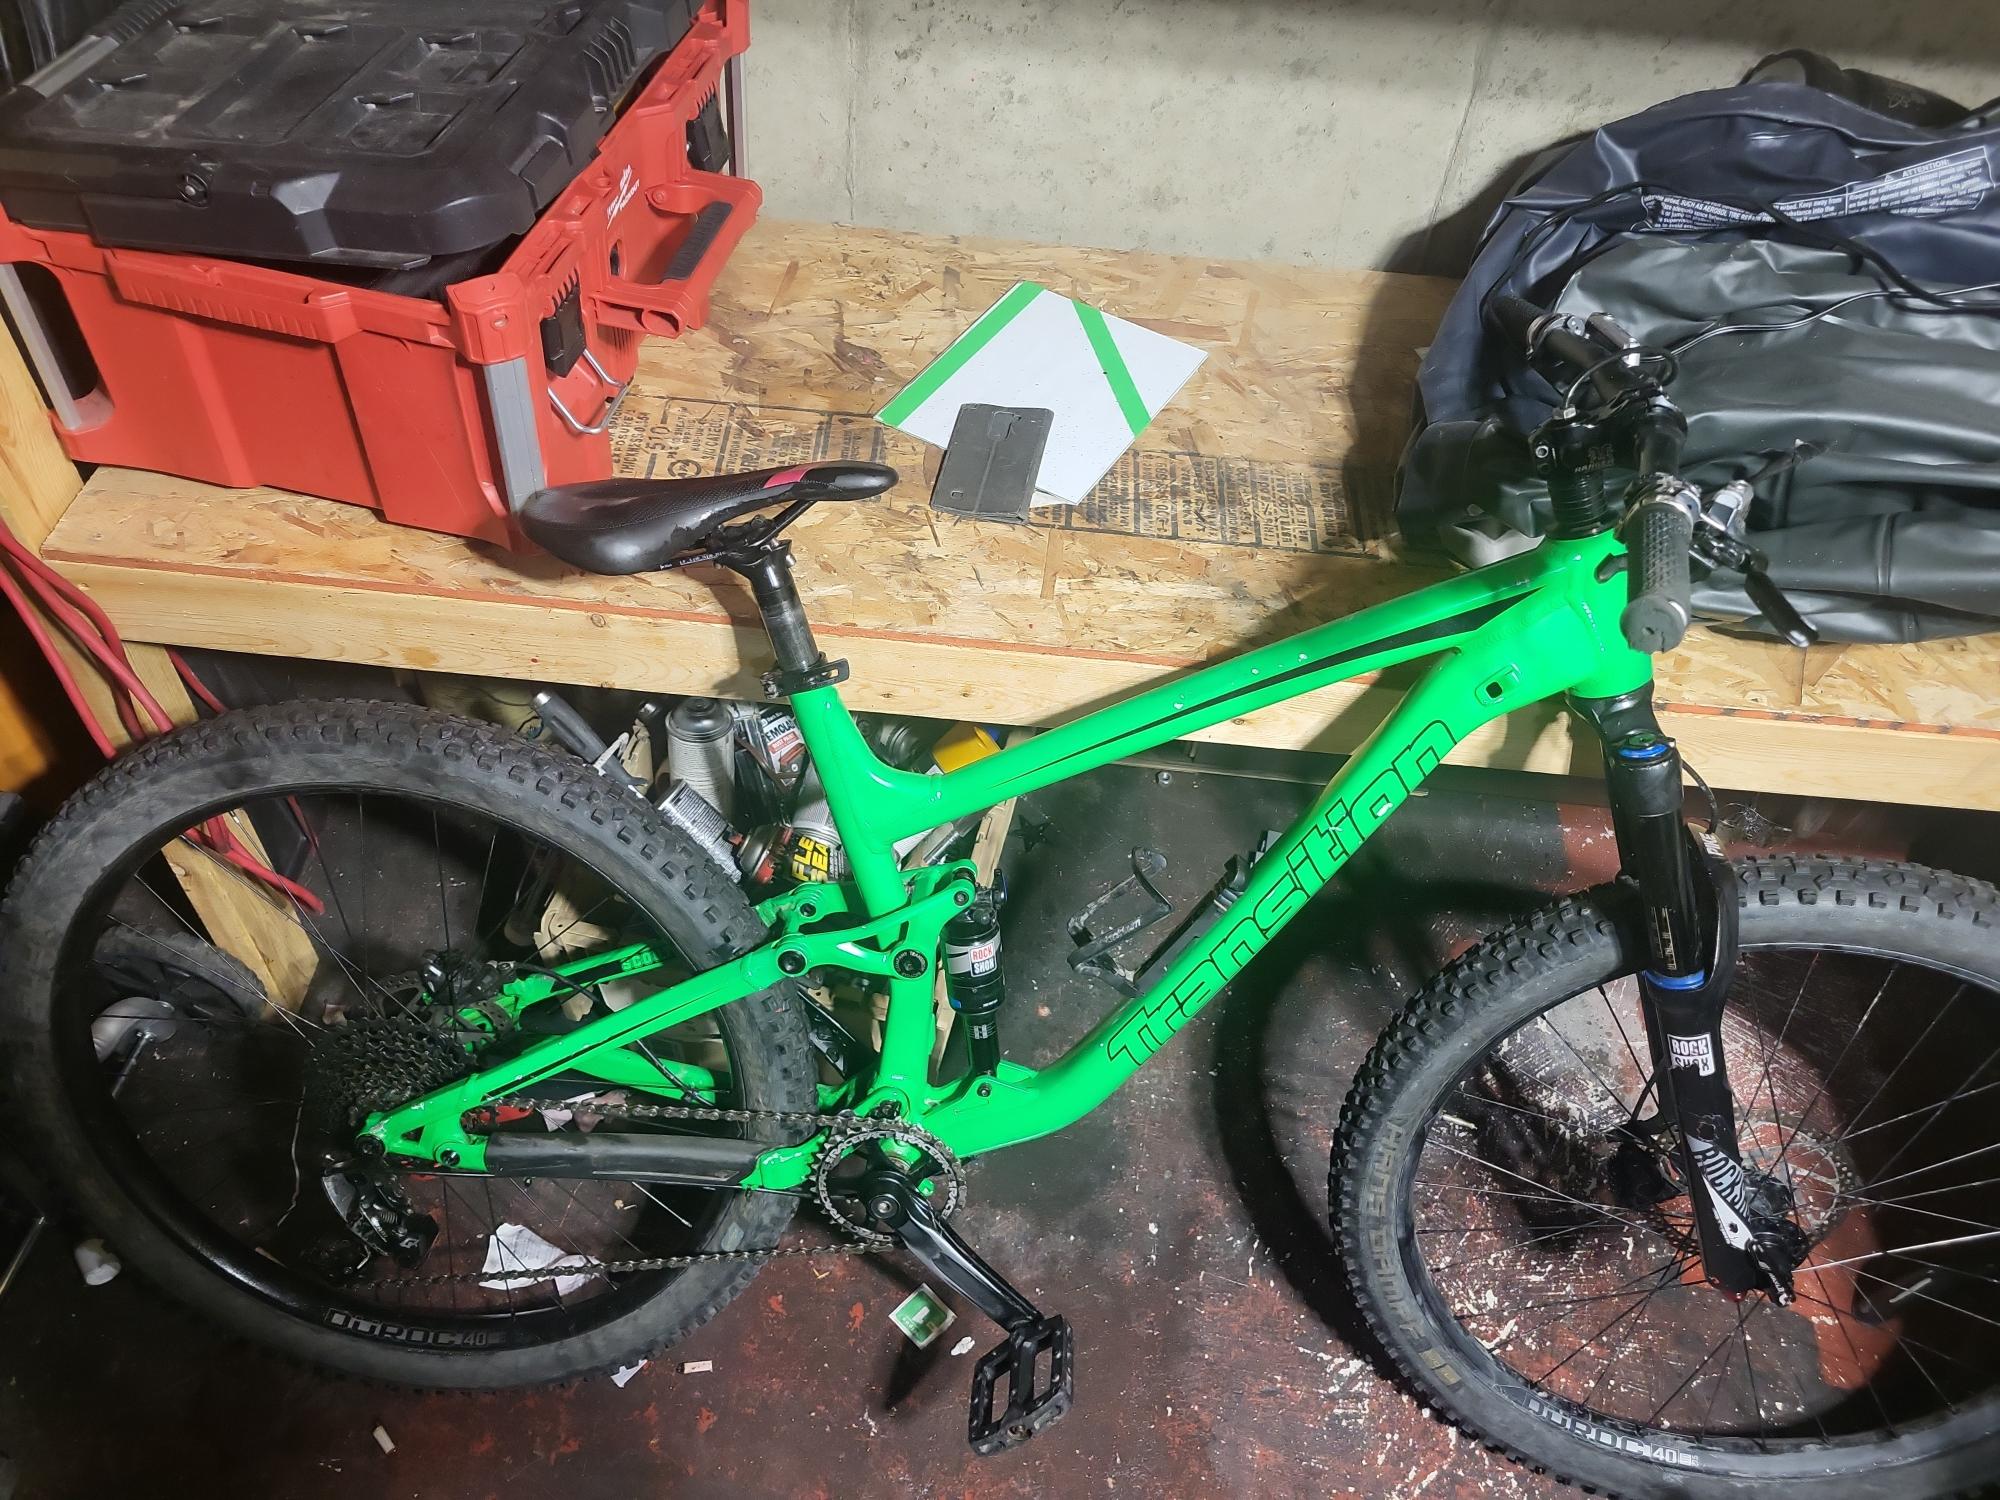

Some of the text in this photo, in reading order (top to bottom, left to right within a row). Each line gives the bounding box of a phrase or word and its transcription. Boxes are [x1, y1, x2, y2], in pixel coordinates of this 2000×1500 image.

[611, 415, 634, 464] EXPOSURE
[619, 436, 645, 475] THICKNESS
[792, 836, 815, 883] FLE
[810, 843, 830, 883] SEA
[1107, 719, 1457, 1065] Transition
[972, 944, 993, 961] ROCK
[1671, 1038, 1709, 1057] ROCK
[463, 1329, 487, 1346] 40
[1522, 1392, 1678, 1465] DUROC 40
